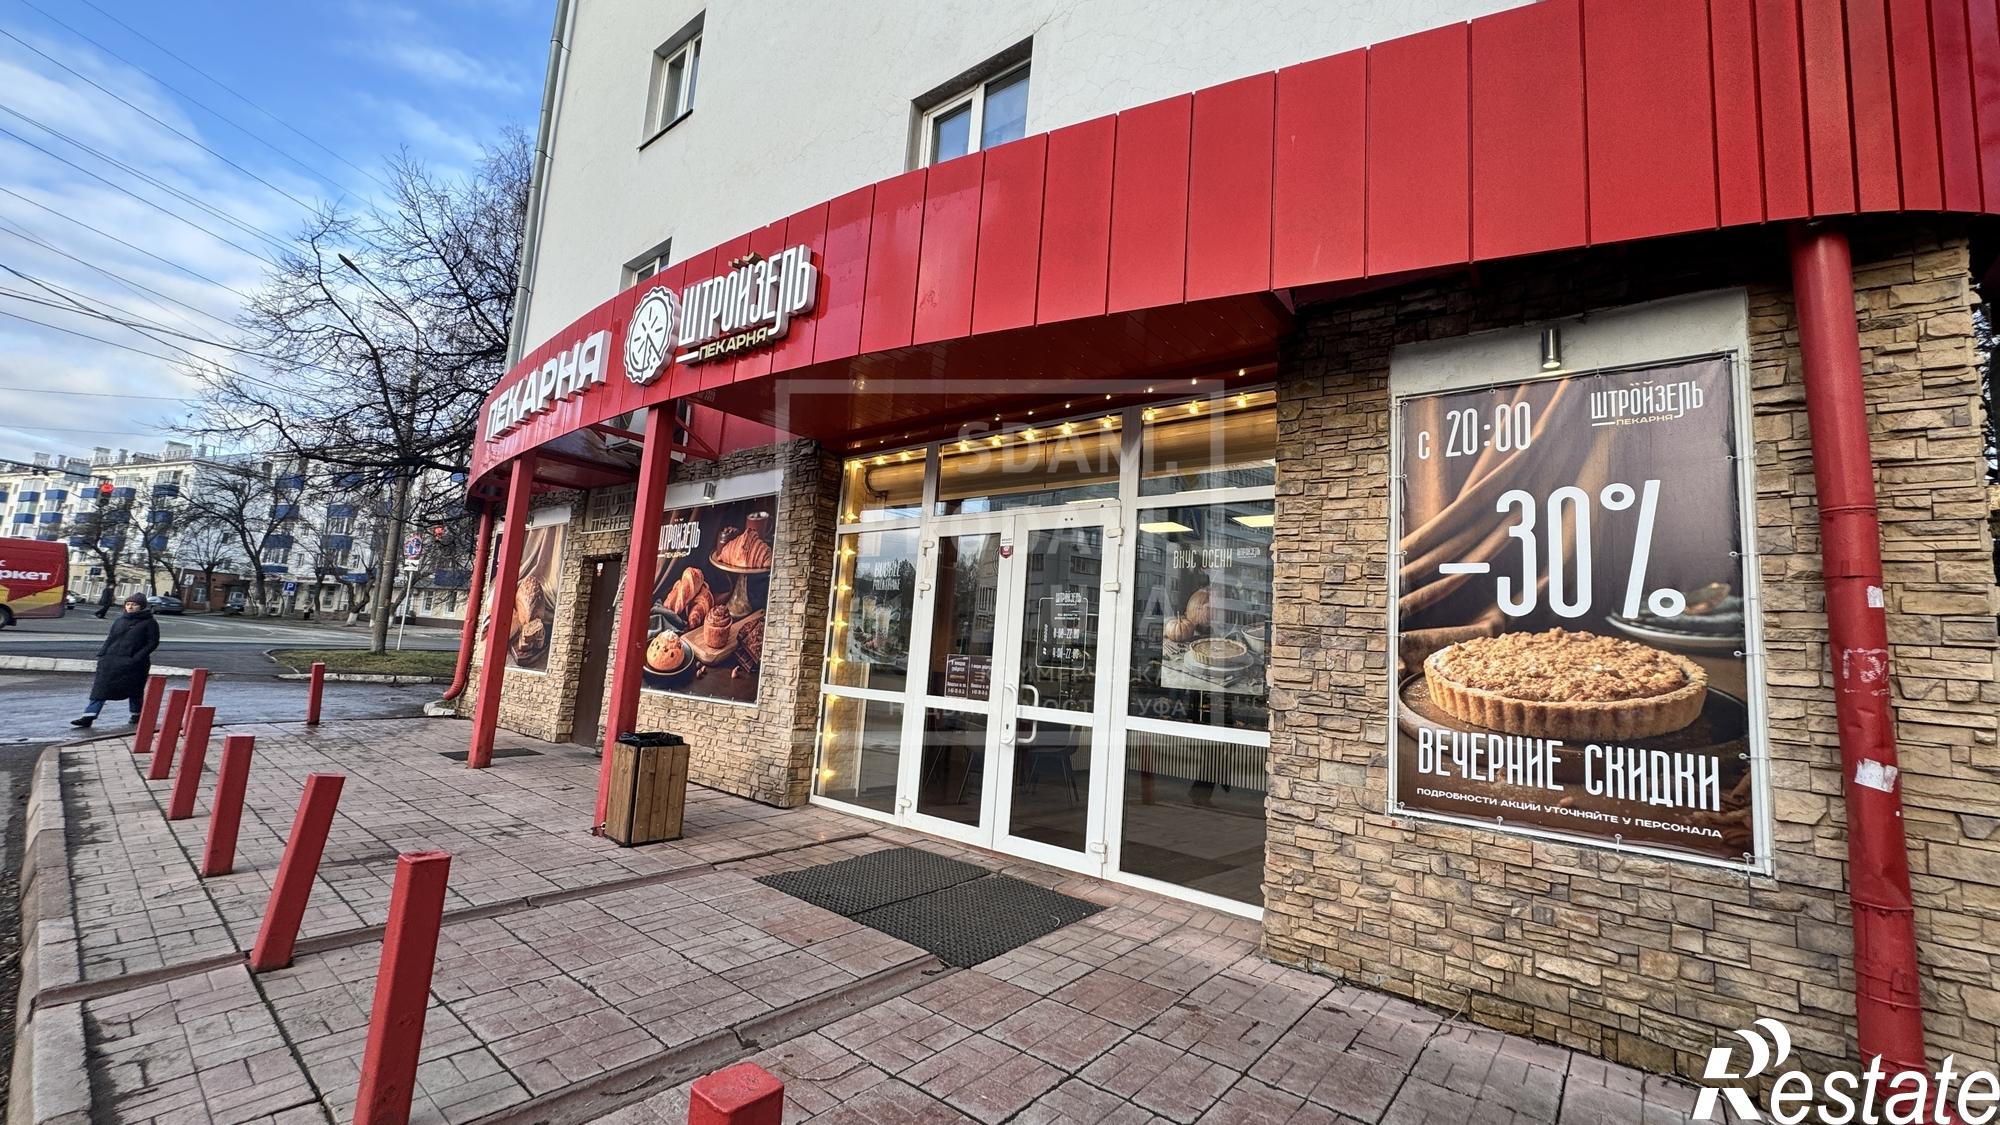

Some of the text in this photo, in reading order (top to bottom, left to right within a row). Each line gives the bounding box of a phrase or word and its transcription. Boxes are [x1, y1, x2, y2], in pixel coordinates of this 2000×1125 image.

[699, 326, 768, 360] ПЕКАРНЯ
[485, 330, 610, 442] ПЕКАРНЯ
[1446, 401, 1531, 458] 20:00
[1616, 413, 1673, 426] ПЕКАРНЯ
[1173, 550, 1197, 569] ВКУС
[1202, 548, 1233, 568] ОСЕНИ
[1418, 727, 1721, 812] ВЕЧЕРНИЕ СКИДКИ
[1416, 787, 1723, 839] ПОДРОБНОСТИ АКЦИИ УТОЧНЯЙТЕ У ПЕРСОНАЛА
